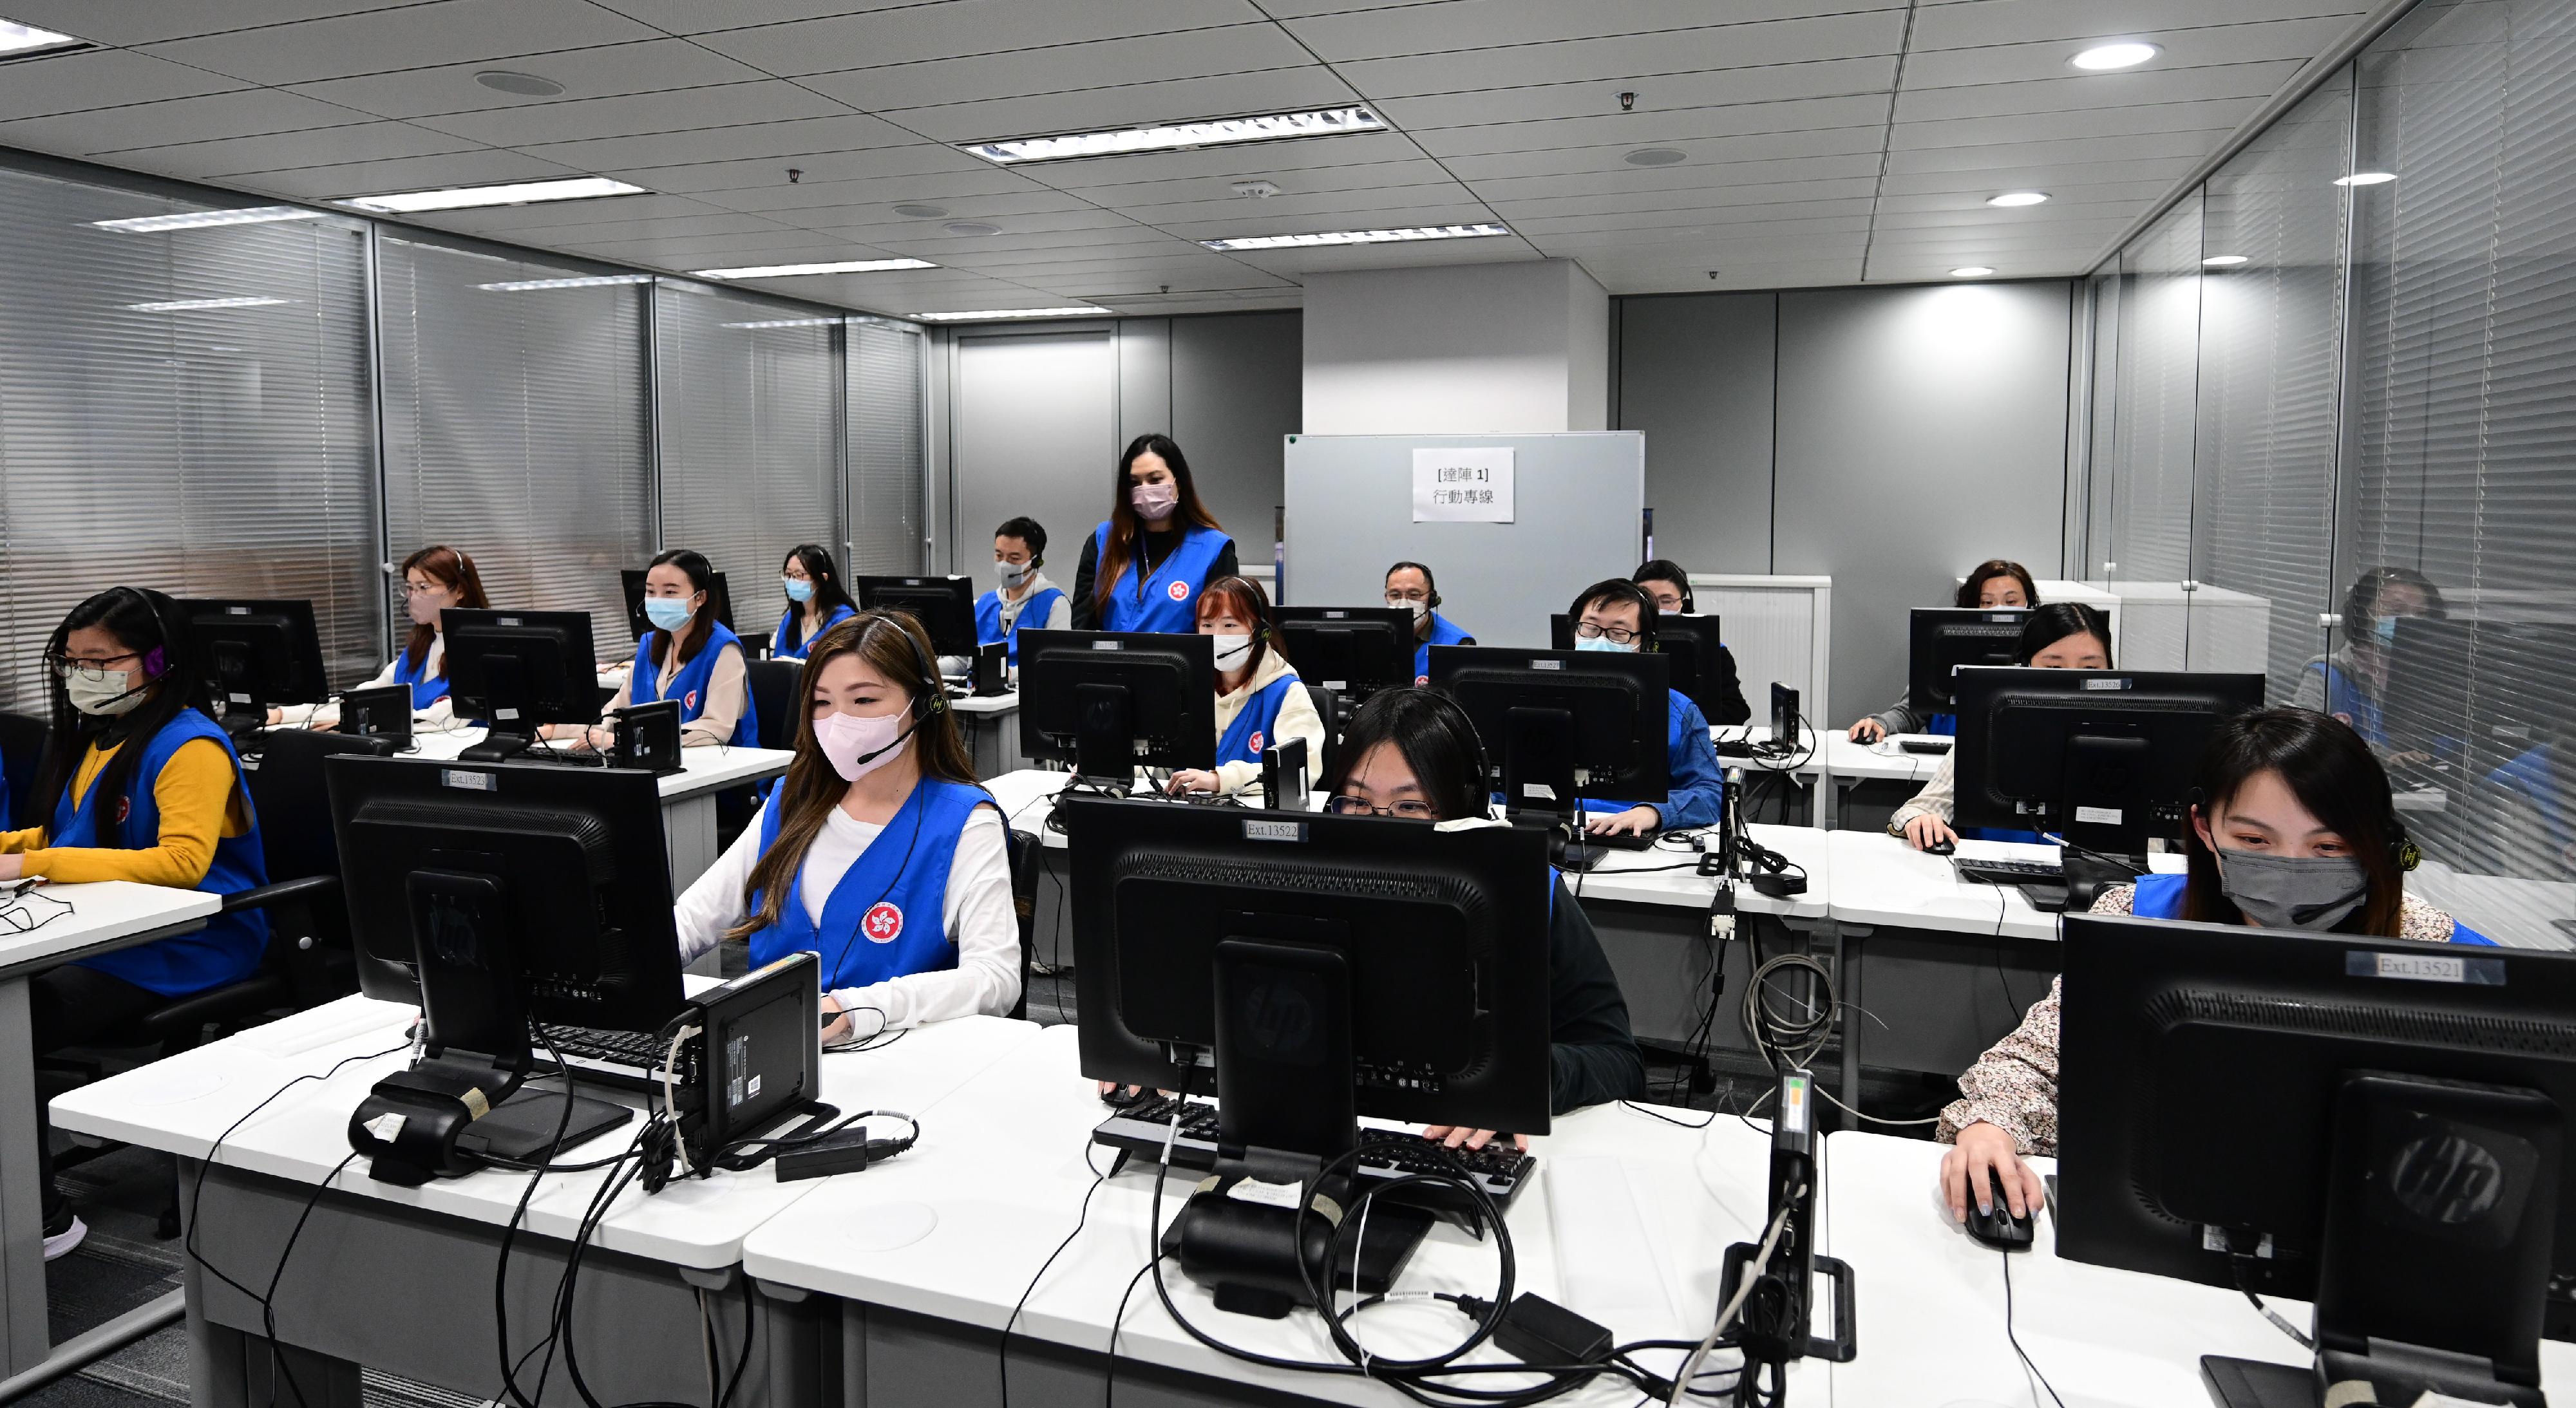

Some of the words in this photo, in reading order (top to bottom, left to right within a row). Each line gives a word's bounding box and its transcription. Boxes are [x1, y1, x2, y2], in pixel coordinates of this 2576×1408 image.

[1438, 467, 1472, 482] [達陣
[1477, 468, 1488, 482] 1]
[1434, 489, 1493, 504] 行動專線
[451, 773, 485, 785] Ext.13523
[1248, 823, 1298, 837] Ext.13522
[2380, 957, 2460, 977] Ext.13521
